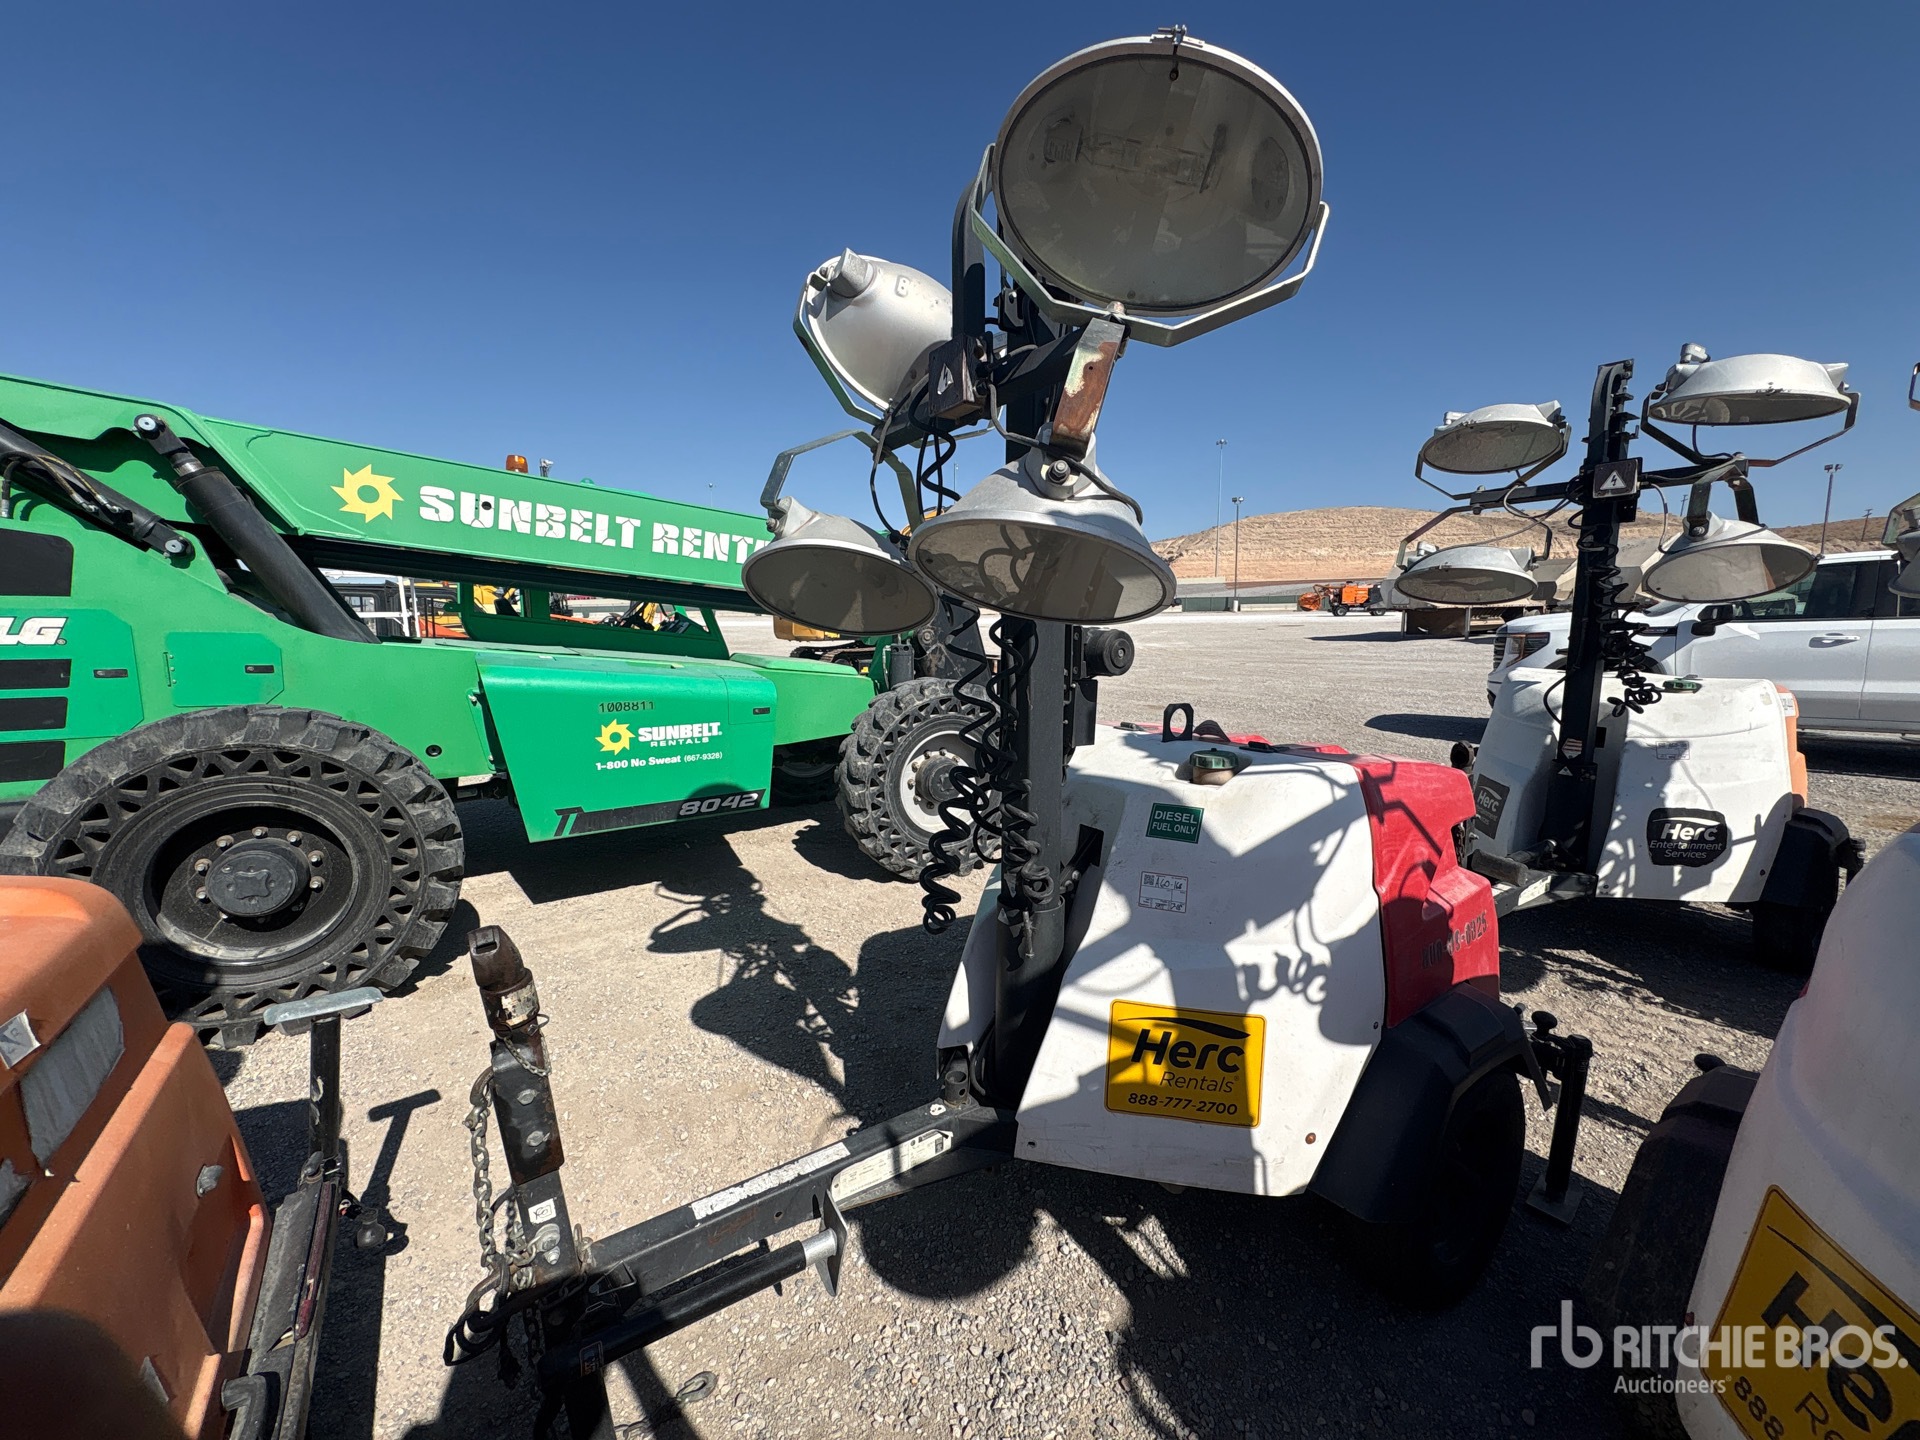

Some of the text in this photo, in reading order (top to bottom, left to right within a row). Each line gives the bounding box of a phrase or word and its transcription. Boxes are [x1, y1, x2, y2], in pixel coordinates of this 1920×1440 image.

[418, 485, 642, 548] SUNBELT
[650, 737, 710, 748] RENTALS
[595, 751, 723, 771] 1-800 No Sweat (667-9328)
[679, 792, 759, 816] 8042
[1477, 790, 1500, 812] Herc
[1154, 810, 1198, 824] DIESEL
[1152, 821, 1197, 835] FUEL ONLY
[1660, 823, 1718, 841] Herc
[1650, 840, 1723, 851] Entertainment
[1664, 849, 1708, 859] Services
[1131, 1028, 1245, 1073] Herc
[1160, 1071, 1235, 1094] Rentals
[1127, 1092, 1238, 1116] 888-777-2700
[1761, 1270, 1920, 1440] He
